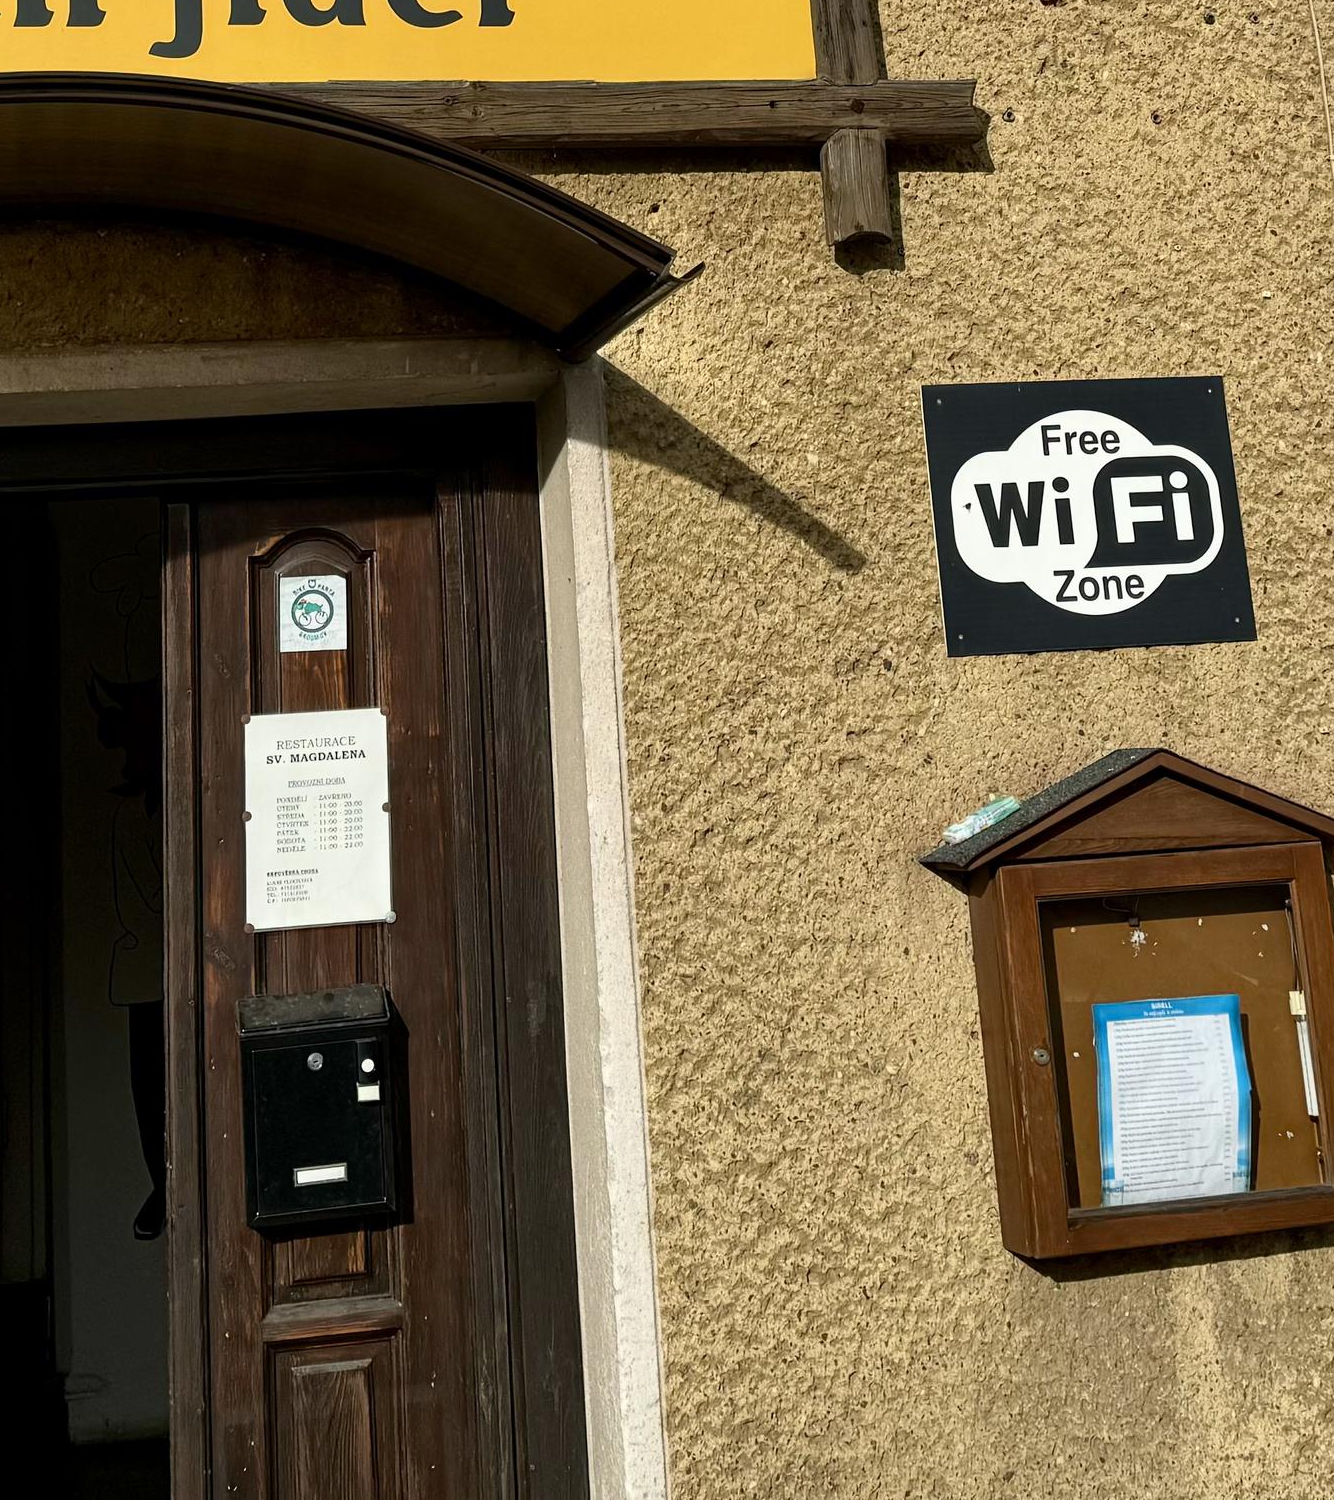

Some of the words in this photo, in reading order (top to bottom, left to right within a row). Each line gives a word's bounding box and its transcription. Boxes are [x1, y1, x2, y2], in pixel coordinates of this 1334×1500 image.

[1040, 424, 1121, 456] Free
[1053, 570, 1145, 603] Zone
[276, 735, 356, 750] RESTAURACE
[266, 754, 286, 765] SV.
[290, 749, 366, 763] MAGDALENA
